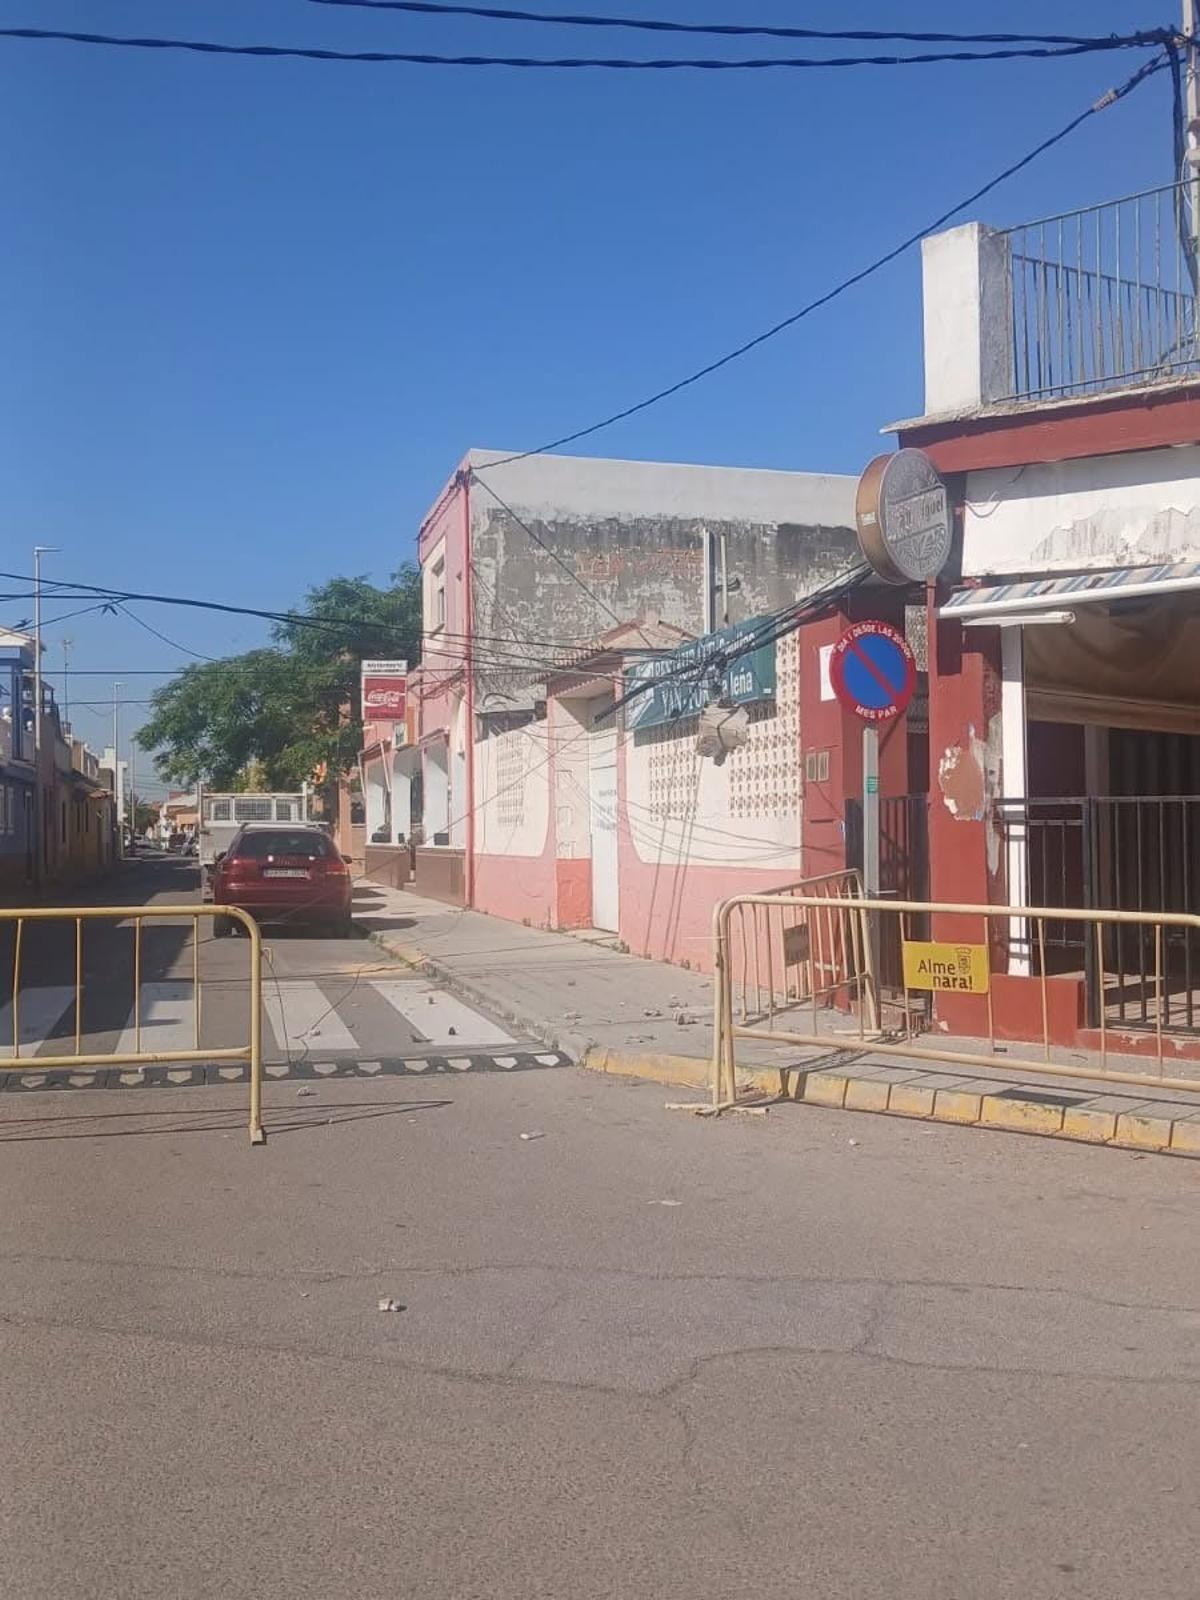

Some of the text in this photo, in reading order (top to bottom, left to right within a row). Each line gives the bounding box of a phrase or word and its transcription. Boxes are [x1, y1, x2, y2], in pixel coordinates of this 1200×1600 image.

[730, 666, 753, 697] leña
[855, 704, 897, 719] MES PAR
[918, 957, 956, 976] Alme
